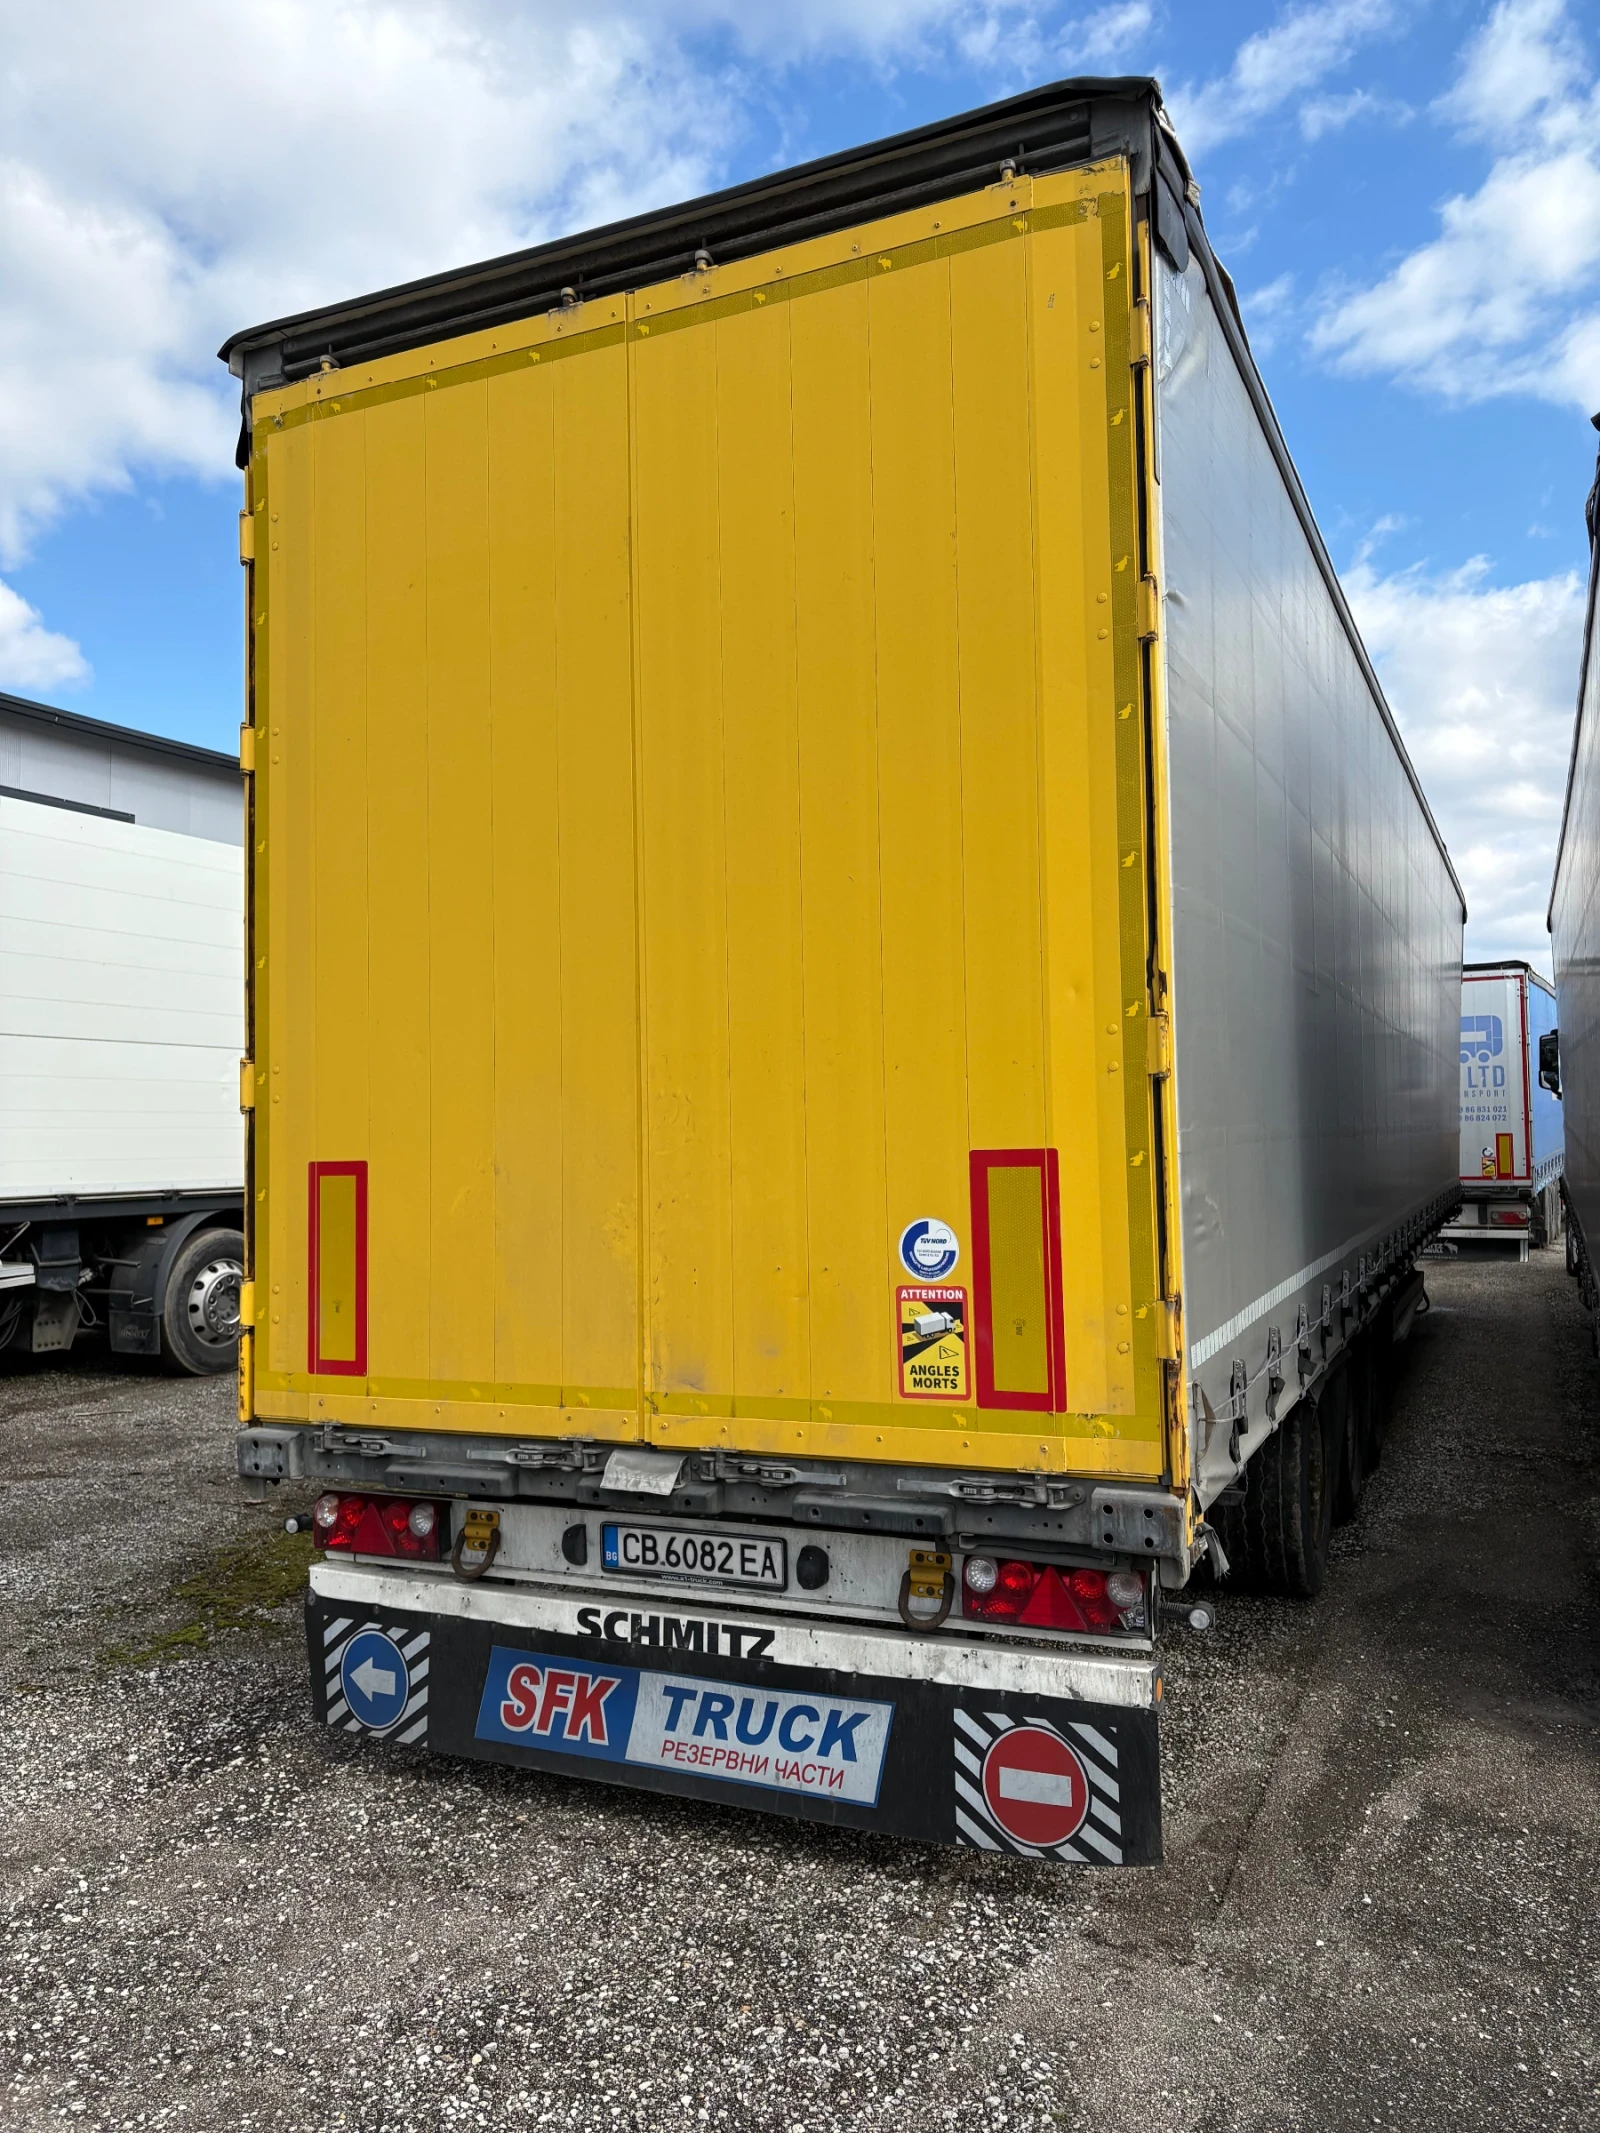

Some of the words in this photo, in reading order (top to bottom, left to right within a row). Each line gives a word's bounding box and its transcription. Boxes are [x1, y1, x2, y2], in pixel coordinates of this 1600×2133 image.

[1467, 1065, 1505, 1088] LTD
[1463, 1089, 1506, 1098] NSPORT
[1465, 1105, 1475, 1113] 86
[1476, 1105, 1491, 1113] 831
[1492, 1105, 1507, 1113] 021
[1475, 1114, 1490, 1122] 824
[1491, 1114, 1507, 1122] 072
[901, 1289, 963, 1299] ATTENTION
[909, 1364, 960, 1377] ANGLES
[913, 1377, 958, 1389] MORTS
[605, 1551, 618, 1561] BG
[661, 1574, 723, 1586] www.a1-truck.com
[577, 1607, 775, 1662] SCHMITZ
[500, 1662, 621, 1746] SFK
[662, 1685, 871, 1762] TRUCK
[661, 1739, 769, 1776] РЕЗЕРВНИ
[775, 1758, 844, 1790] ЧАСТИ
